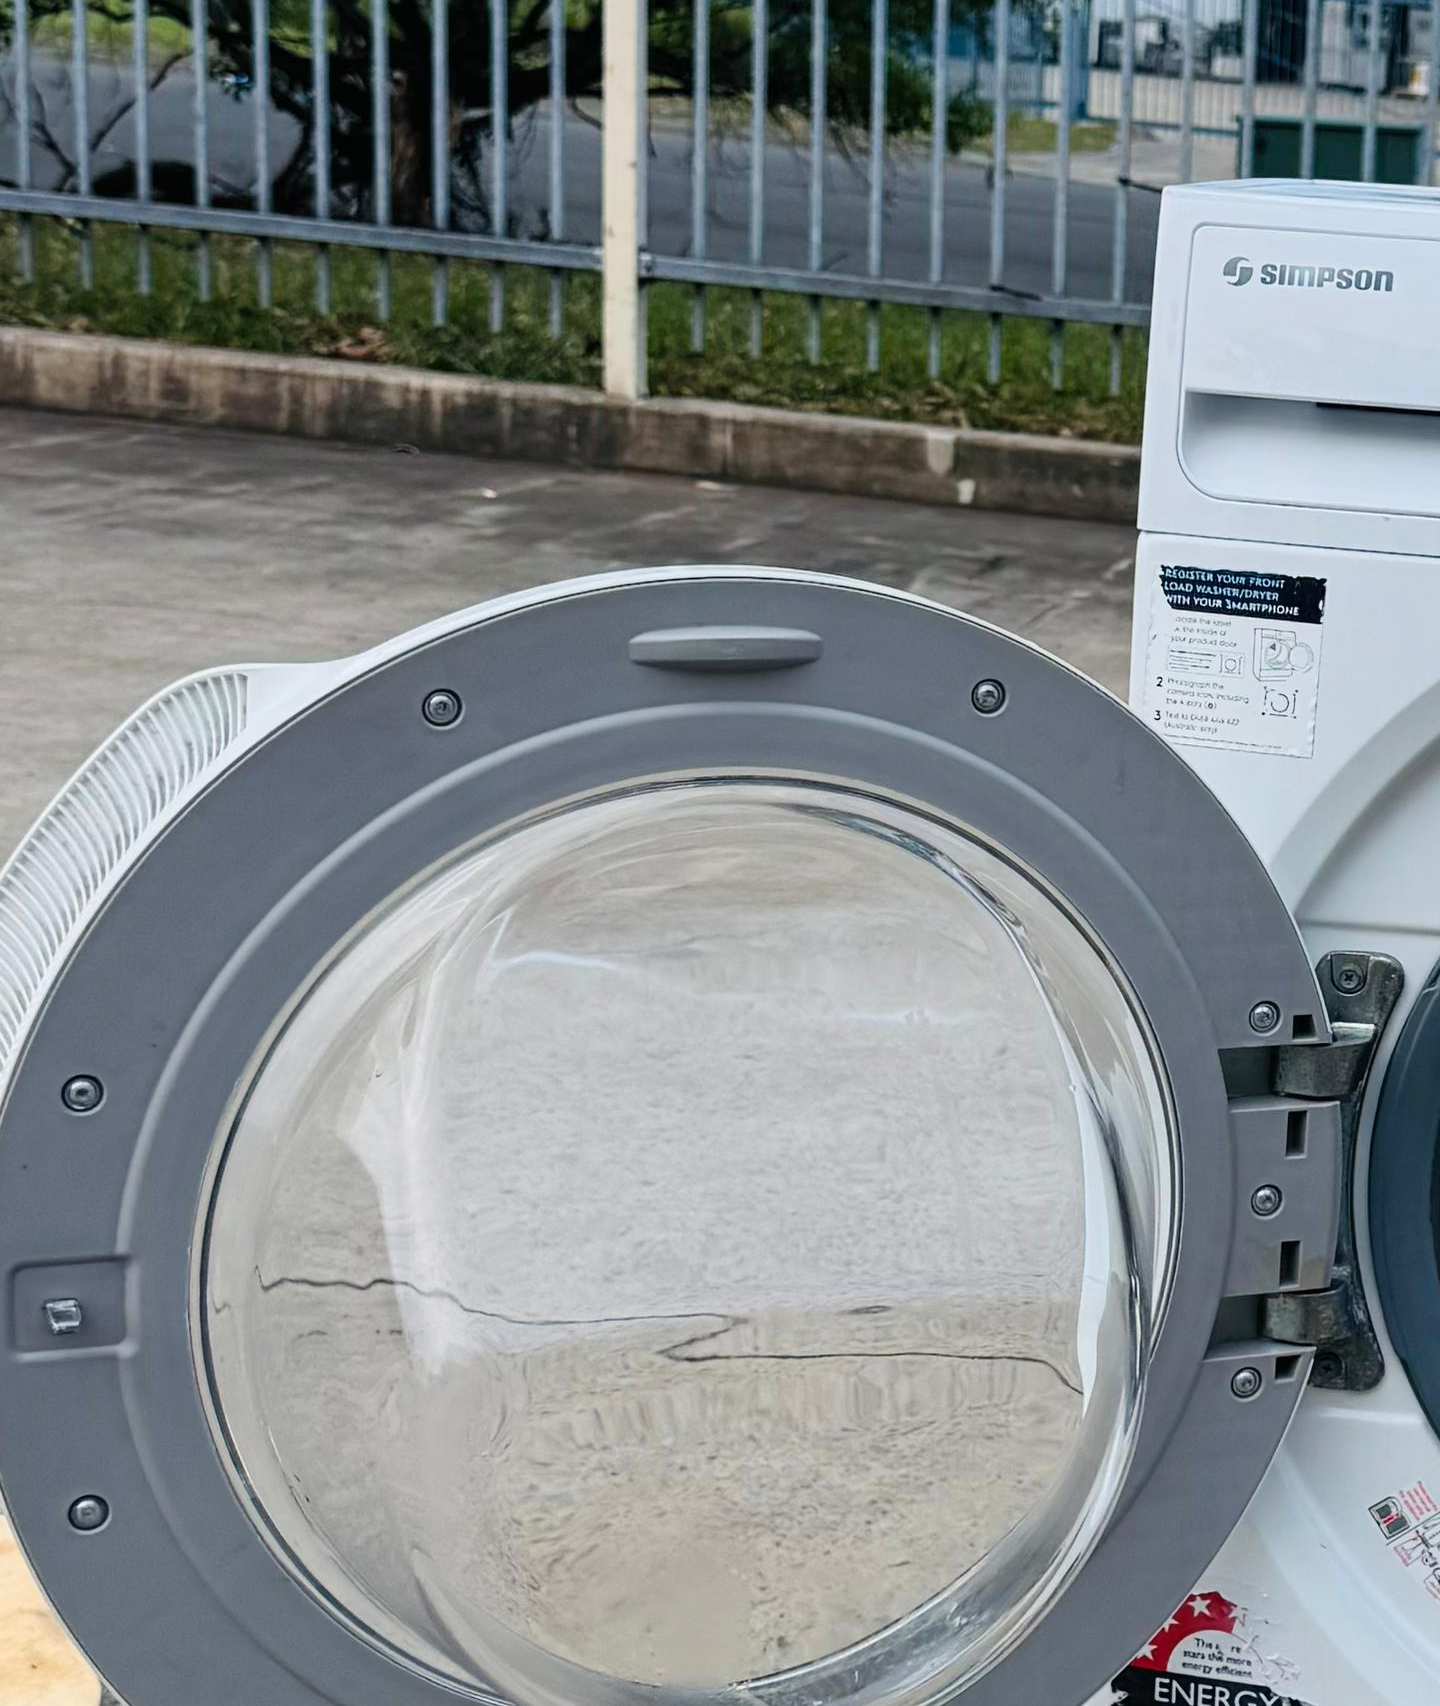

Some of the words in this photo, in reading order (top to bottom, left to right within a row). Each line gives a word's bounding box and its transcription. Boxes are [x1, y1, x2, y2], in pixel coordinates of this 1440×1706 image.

[1260, 263, 1394, 292] SIMPSON
[1216, 573, 1246, 586] YOUR
[1249, 576, 1286, 589] FRONT
[1163, 582, 1194, 594] LOAD
[1193, 596, 1223, 609] YOUR
[1225, 599, 1300, 616] SMARTPHONE
[1156, 676, 1164, 688] 2
[1153, 709, 1162, 721] 3
[1226, 1655, 1253, 1666] more
